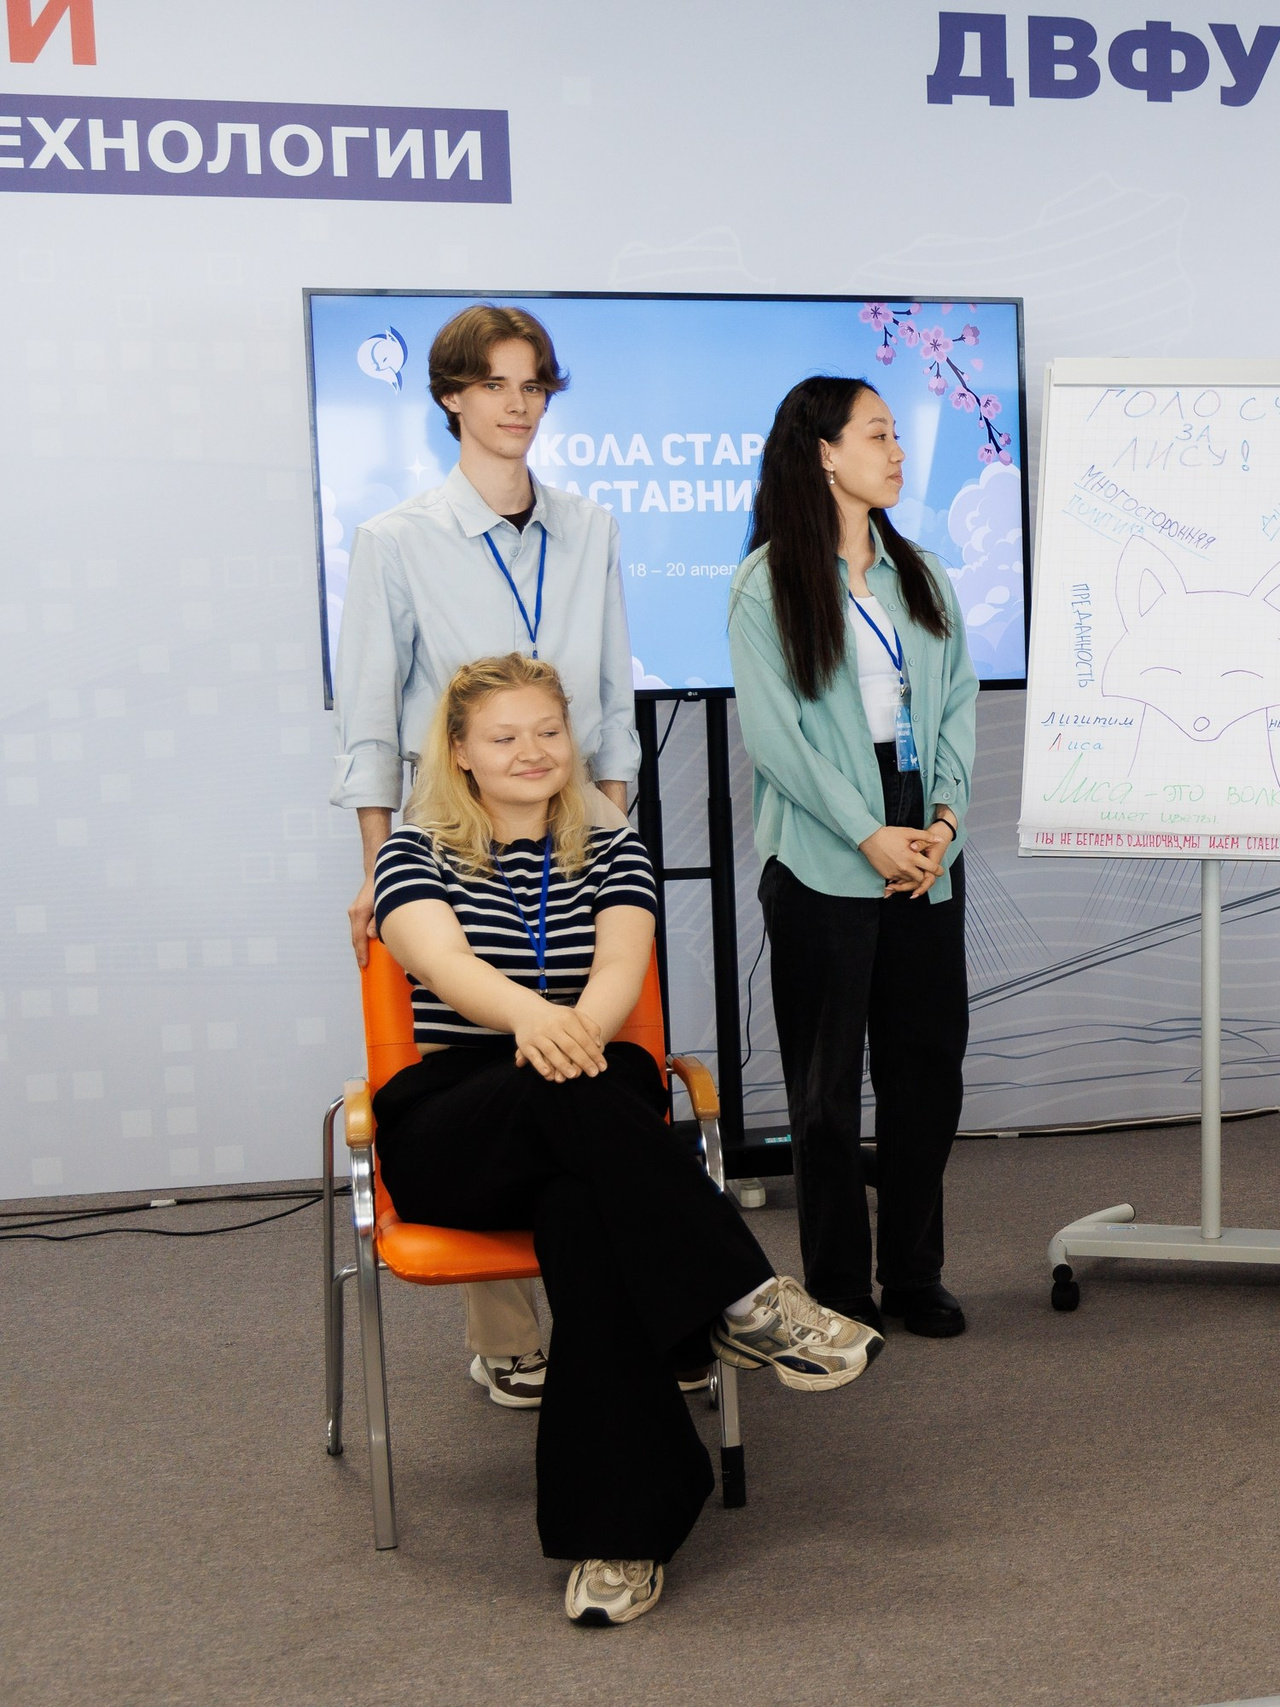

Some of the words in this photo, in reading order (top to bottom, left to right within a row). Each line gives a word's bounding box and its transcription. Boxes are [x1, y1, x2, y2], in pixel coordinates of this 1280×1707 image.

[1175, 424, 1211, 443] ЗА
[527, 433, 654, 467] КОЛА
[549, 480, 758, 513] АСТАВНИ
[1080, 464, 1216, 550] МНОГОСТОРОННЯЯ
[628, 563, 647, 577] 18
[666, 562, 686, 577] 20
[1070, 583, 1095, 688] ПРЕДАННОСТЬ
[1049, 732, 1104, 751] Лиса
[1060, 832, 1073, 845] НЕ
[1076, 832, 1114, 846] БЕГАЕМ
[1116, 833, 1124, 847] В
